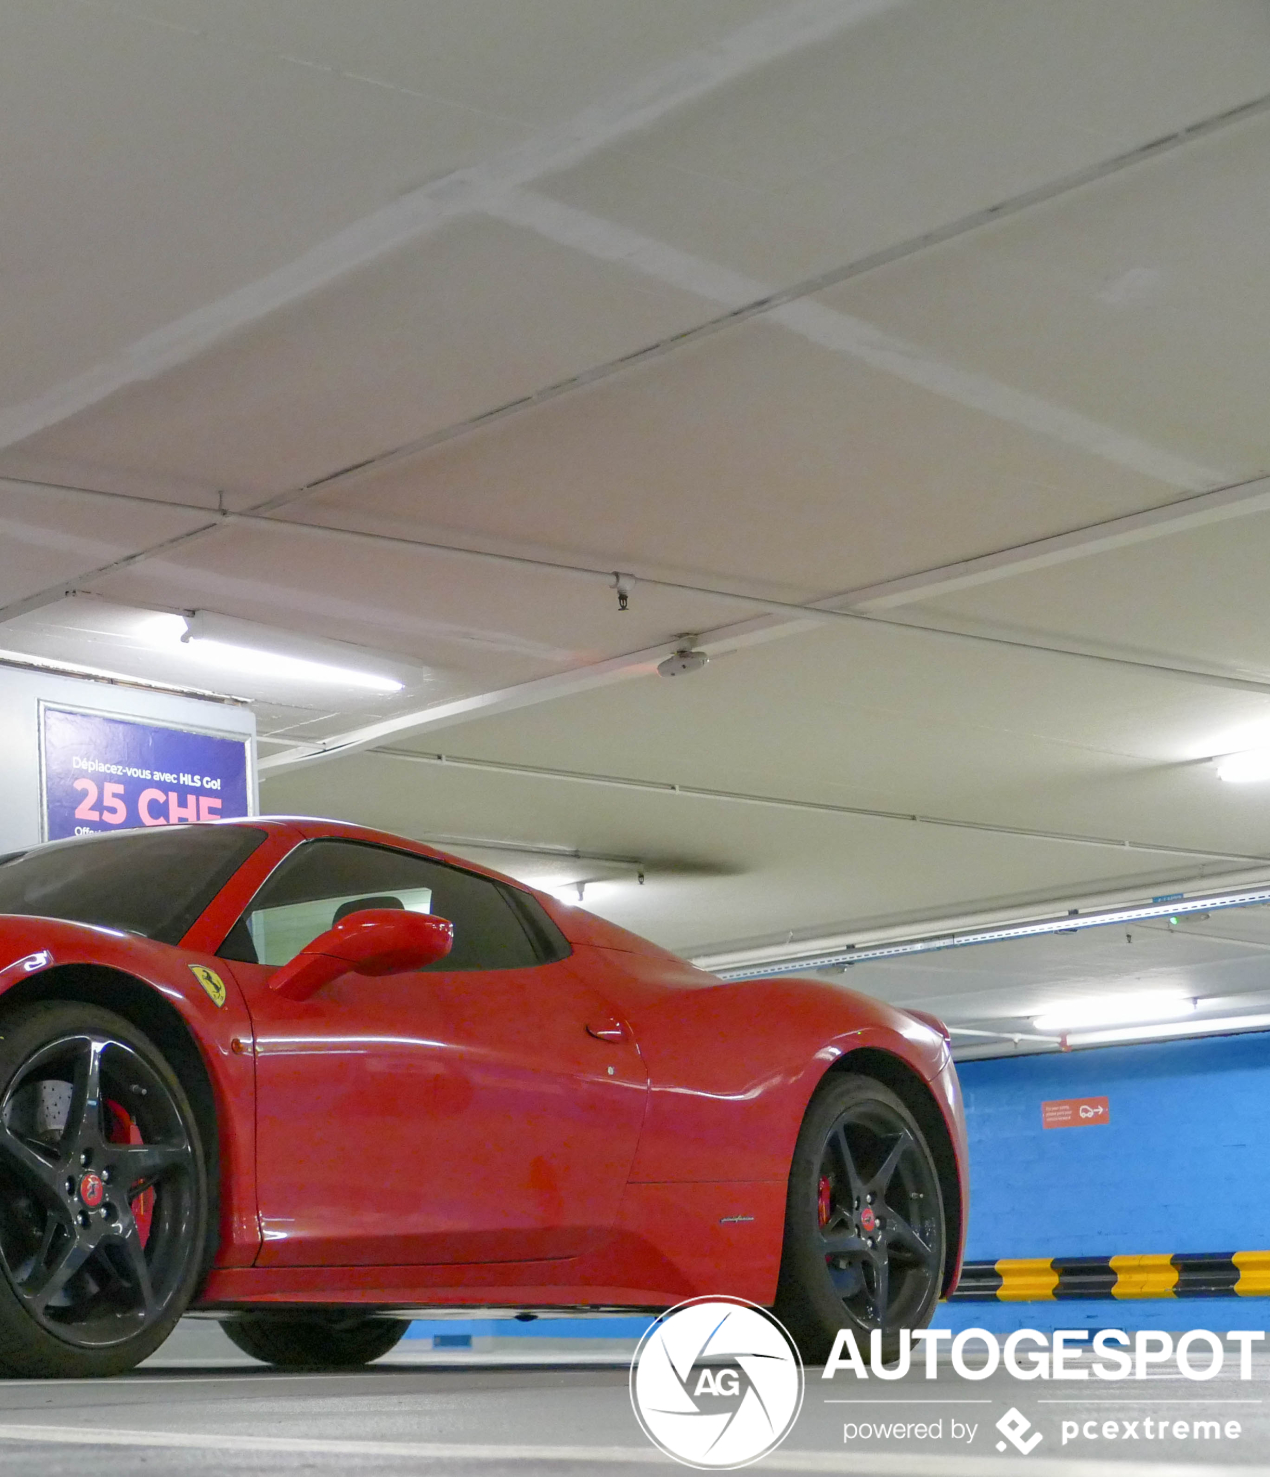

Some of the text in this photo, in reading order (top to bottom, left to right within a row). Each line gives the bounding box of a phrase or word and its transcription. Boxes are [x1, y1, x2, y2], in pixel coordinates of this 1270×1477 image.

[72, 756, 221, 790] Déplacez-vous avec HLS Go!
[73, 778, 128, 825] 25
